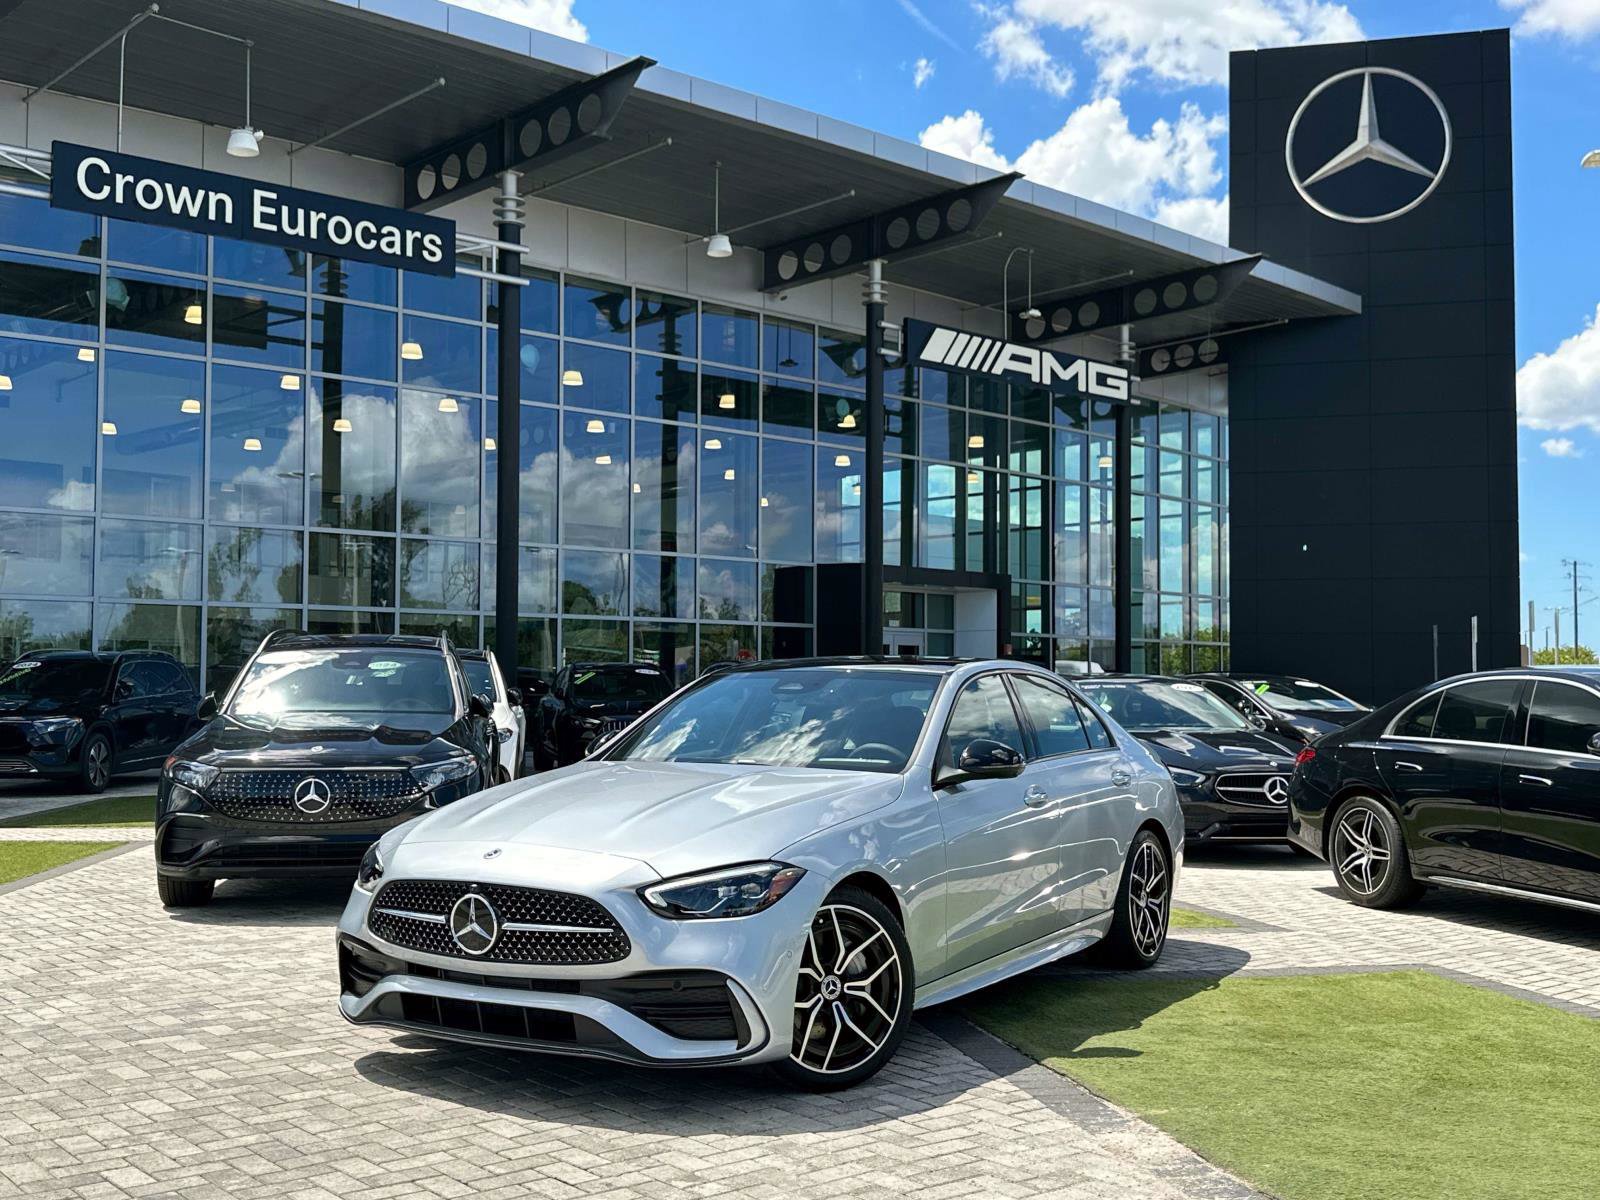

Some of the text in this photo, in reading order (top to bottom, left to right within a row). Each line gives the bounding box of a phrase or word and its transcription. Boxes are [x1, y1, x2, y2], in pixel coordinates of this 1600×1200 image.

[76, 157, 443, 263] Crown Eurocars
[990, 343, 1128, 401] AMG
